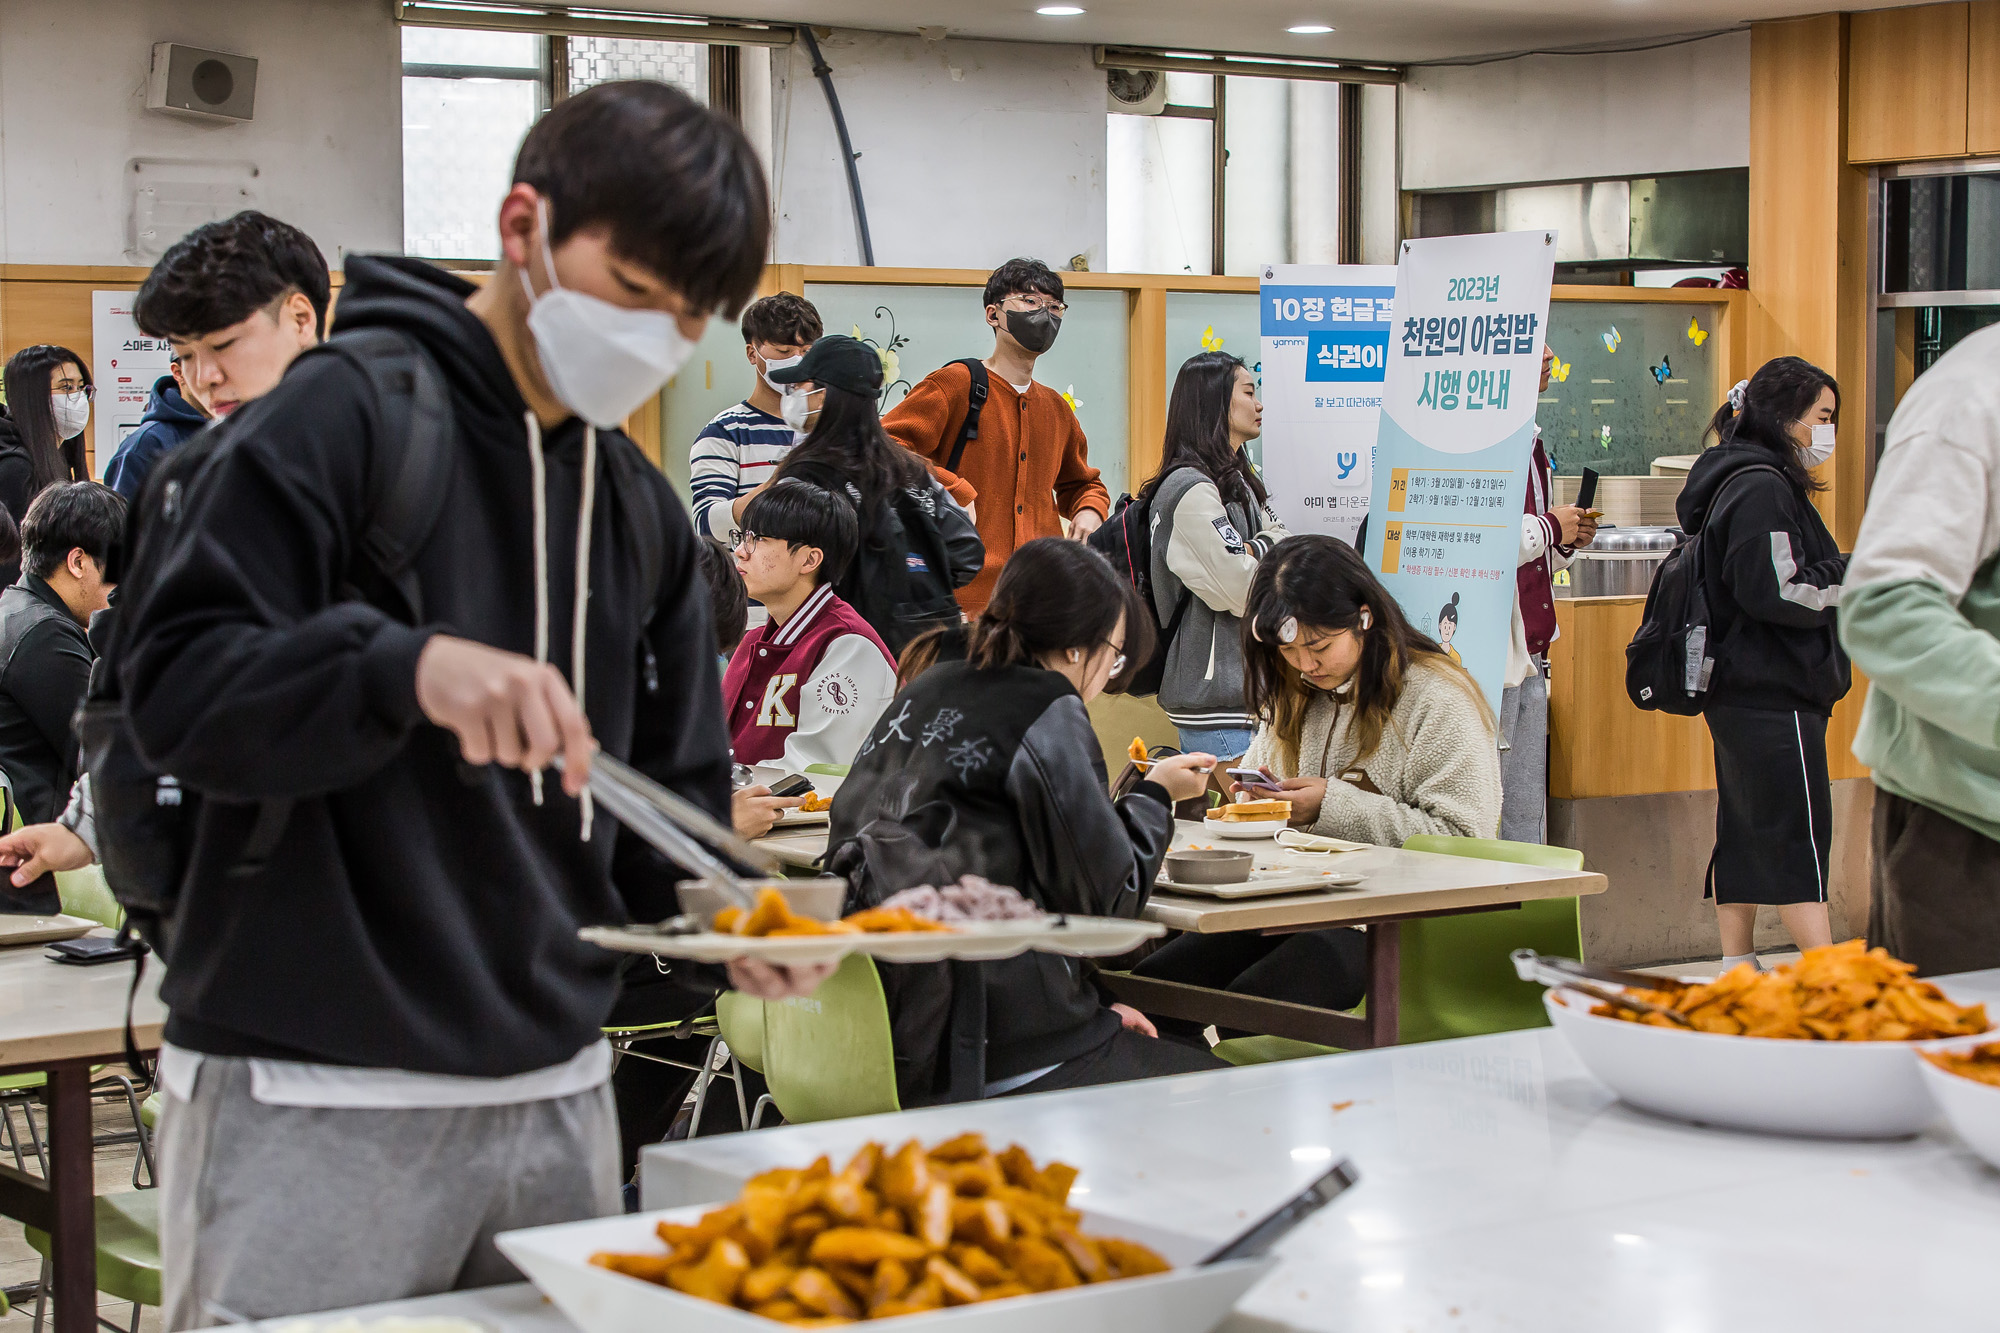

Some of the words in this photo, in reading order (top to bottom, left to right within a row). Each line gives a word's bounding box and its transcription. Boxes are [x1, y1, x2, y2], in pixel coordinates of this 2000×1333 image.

[1448, 275, 1500, 302] 2023년
[1272, 298, 1325, 322] 10장
[1330, 296, 1394, 322] 현금결
[1402, 316, 1467, 356] 천원의
[1471, 314, 1538, 355] 아침밥
[123, 340, 153, 351] 스마트
[1272, 340, 1305, 349] yammi
[1317, 345, 1383, 368] 식권이
[1417, 370, 1462, 410] 시행
[1466, 370, 1510, 410] 안내
[1315, 397, 1324, 407] 잘
[1326, 397, 1344, 407] 보고
[1393, 480, 1406, 491] 기간
[1411, 477, 1426, 488] 1학기
[1431, 477, 1440, 488] 3월
[1442, 478, 1464, 489] 20일(월)
[1471, 478, 1481, 489] 6월
[1482, 479, 1506, 490] 21일(수)
[1304, 496, 1323, 508] 야미
[1327, 496, 1336, 508] 앱
[1340, 496, 1369, 508] 다운로
[1409, 494, 1424, 504] 2학기
[1429, 494, 1439, 505] 9월
[1441, 495, 1459, 506] 1일(금)
[1466, 496, 1479, 507] 12월
[1480, 496, 1505, 508] 21일(목)
[1387, 530, 1401, 541] 대상
[1438, 531, 1455, 543] 재학생
[1456, 532, 1462, 543] 및
[1464, 532, 1481, 544] 휴학생
[1403, 546, 1417, 558] (이용
[1419, 547, 1430, 559] 학기
[1431, 548, 1445, 560] 기준)
[1434, 566, 1444, 577] 필수
[1471, 568, 1476, 578] 후
[817, 673, 840, 701] LIBERTAS
[756, 673, 797, 727] K
[822, 704, 850, 715] VERITAS
[854, 699, 993, 787] 大學校
